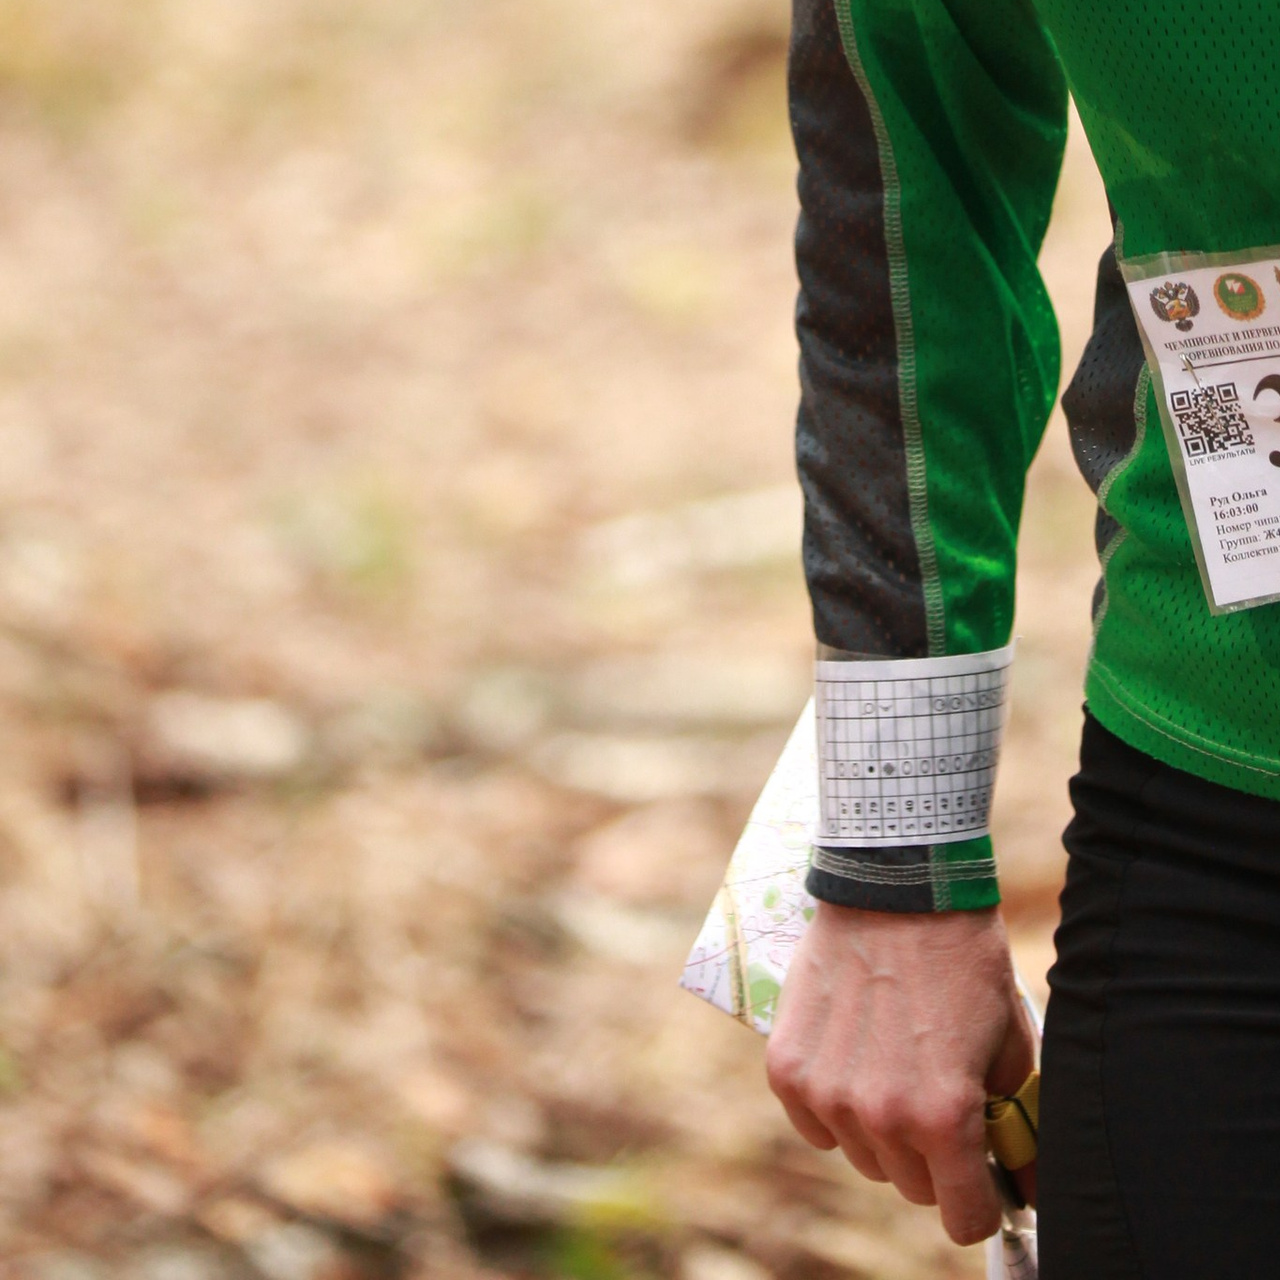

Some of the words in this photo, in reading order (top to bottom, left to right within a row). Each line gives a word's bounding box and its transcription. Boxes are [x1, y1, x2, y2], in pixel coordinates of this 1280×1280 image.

[1164, 332, 1231, 352] ЧЕМПИОНАТ
[1232, 331, 1240, 342] И
[1184, 342, 1266, 361] ОРЕВНОВАНИЯ
[1266, 340, 1280, 351] ПО
[1190, 456, 1206, 466] LIVE
[1207, 448, 1256, 463] РЕЗУЛЬТАТЫ
[1209, 495, 1230, 508] Руд
[1232, 488, 1268, 502] Ольга
[1213, 502, 1259, 521] 16:03:00
[1216, 521, 1252, 536] Номер
[1219, 533, 1261, 551] Группа:
[905, 800, 914, 812] 40
[923, 799, 932, 811] 41
